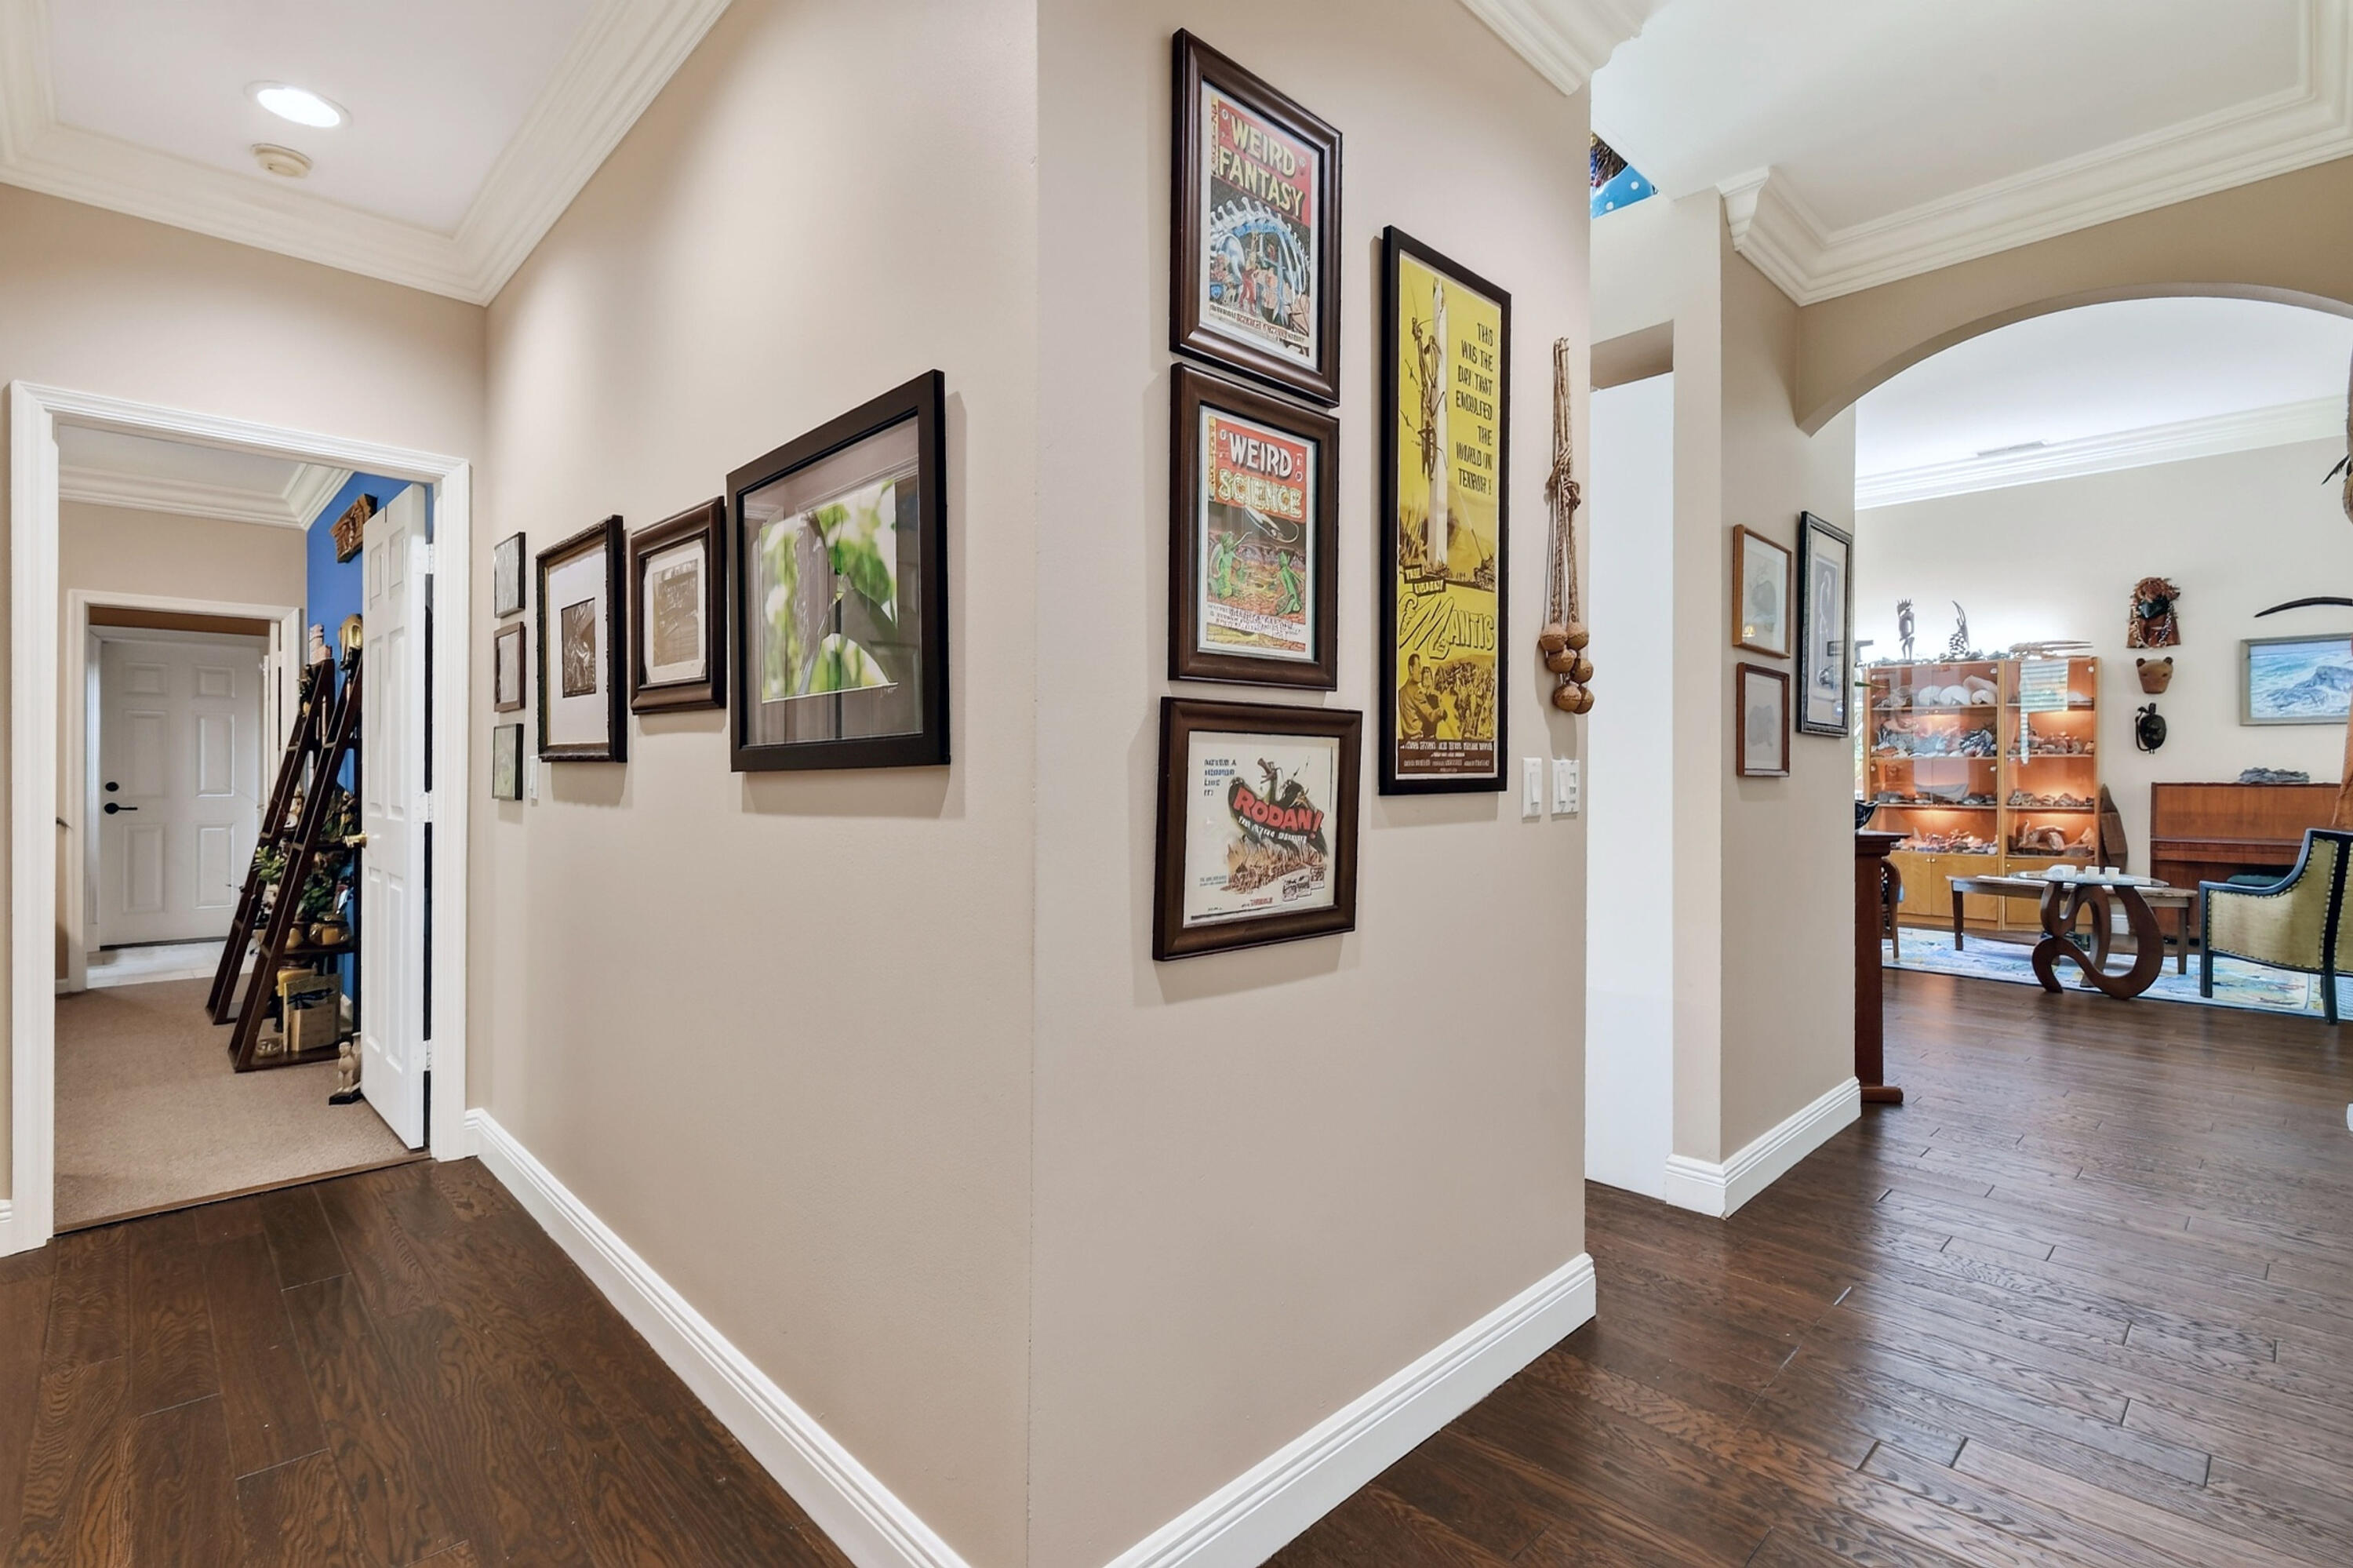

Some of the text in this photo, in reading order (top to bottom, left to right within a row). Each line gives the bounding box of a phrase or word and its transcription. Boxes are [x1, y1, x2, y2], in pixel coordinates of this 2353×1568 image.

[1231, 115, 1297, 176] WEIRD
[1218, 145, 1304, 217] FANTASY
[1461, 339, 1493, 373] WAS THE
[1477, 322, 1493, 347] THIS
[1458, 365, 1493, 396] DAY THAT
[1229, 431, 1293, 478] WEIRD
[1456, 442, 1482, 467] WORLD
[1477, 425, 1493, 446] THE
[1218, 467, 1303, 518] SCIENCE
[1398, 591, 1495, 660] MANTIS
[1233, 786, 1325, 840] RODAN!
